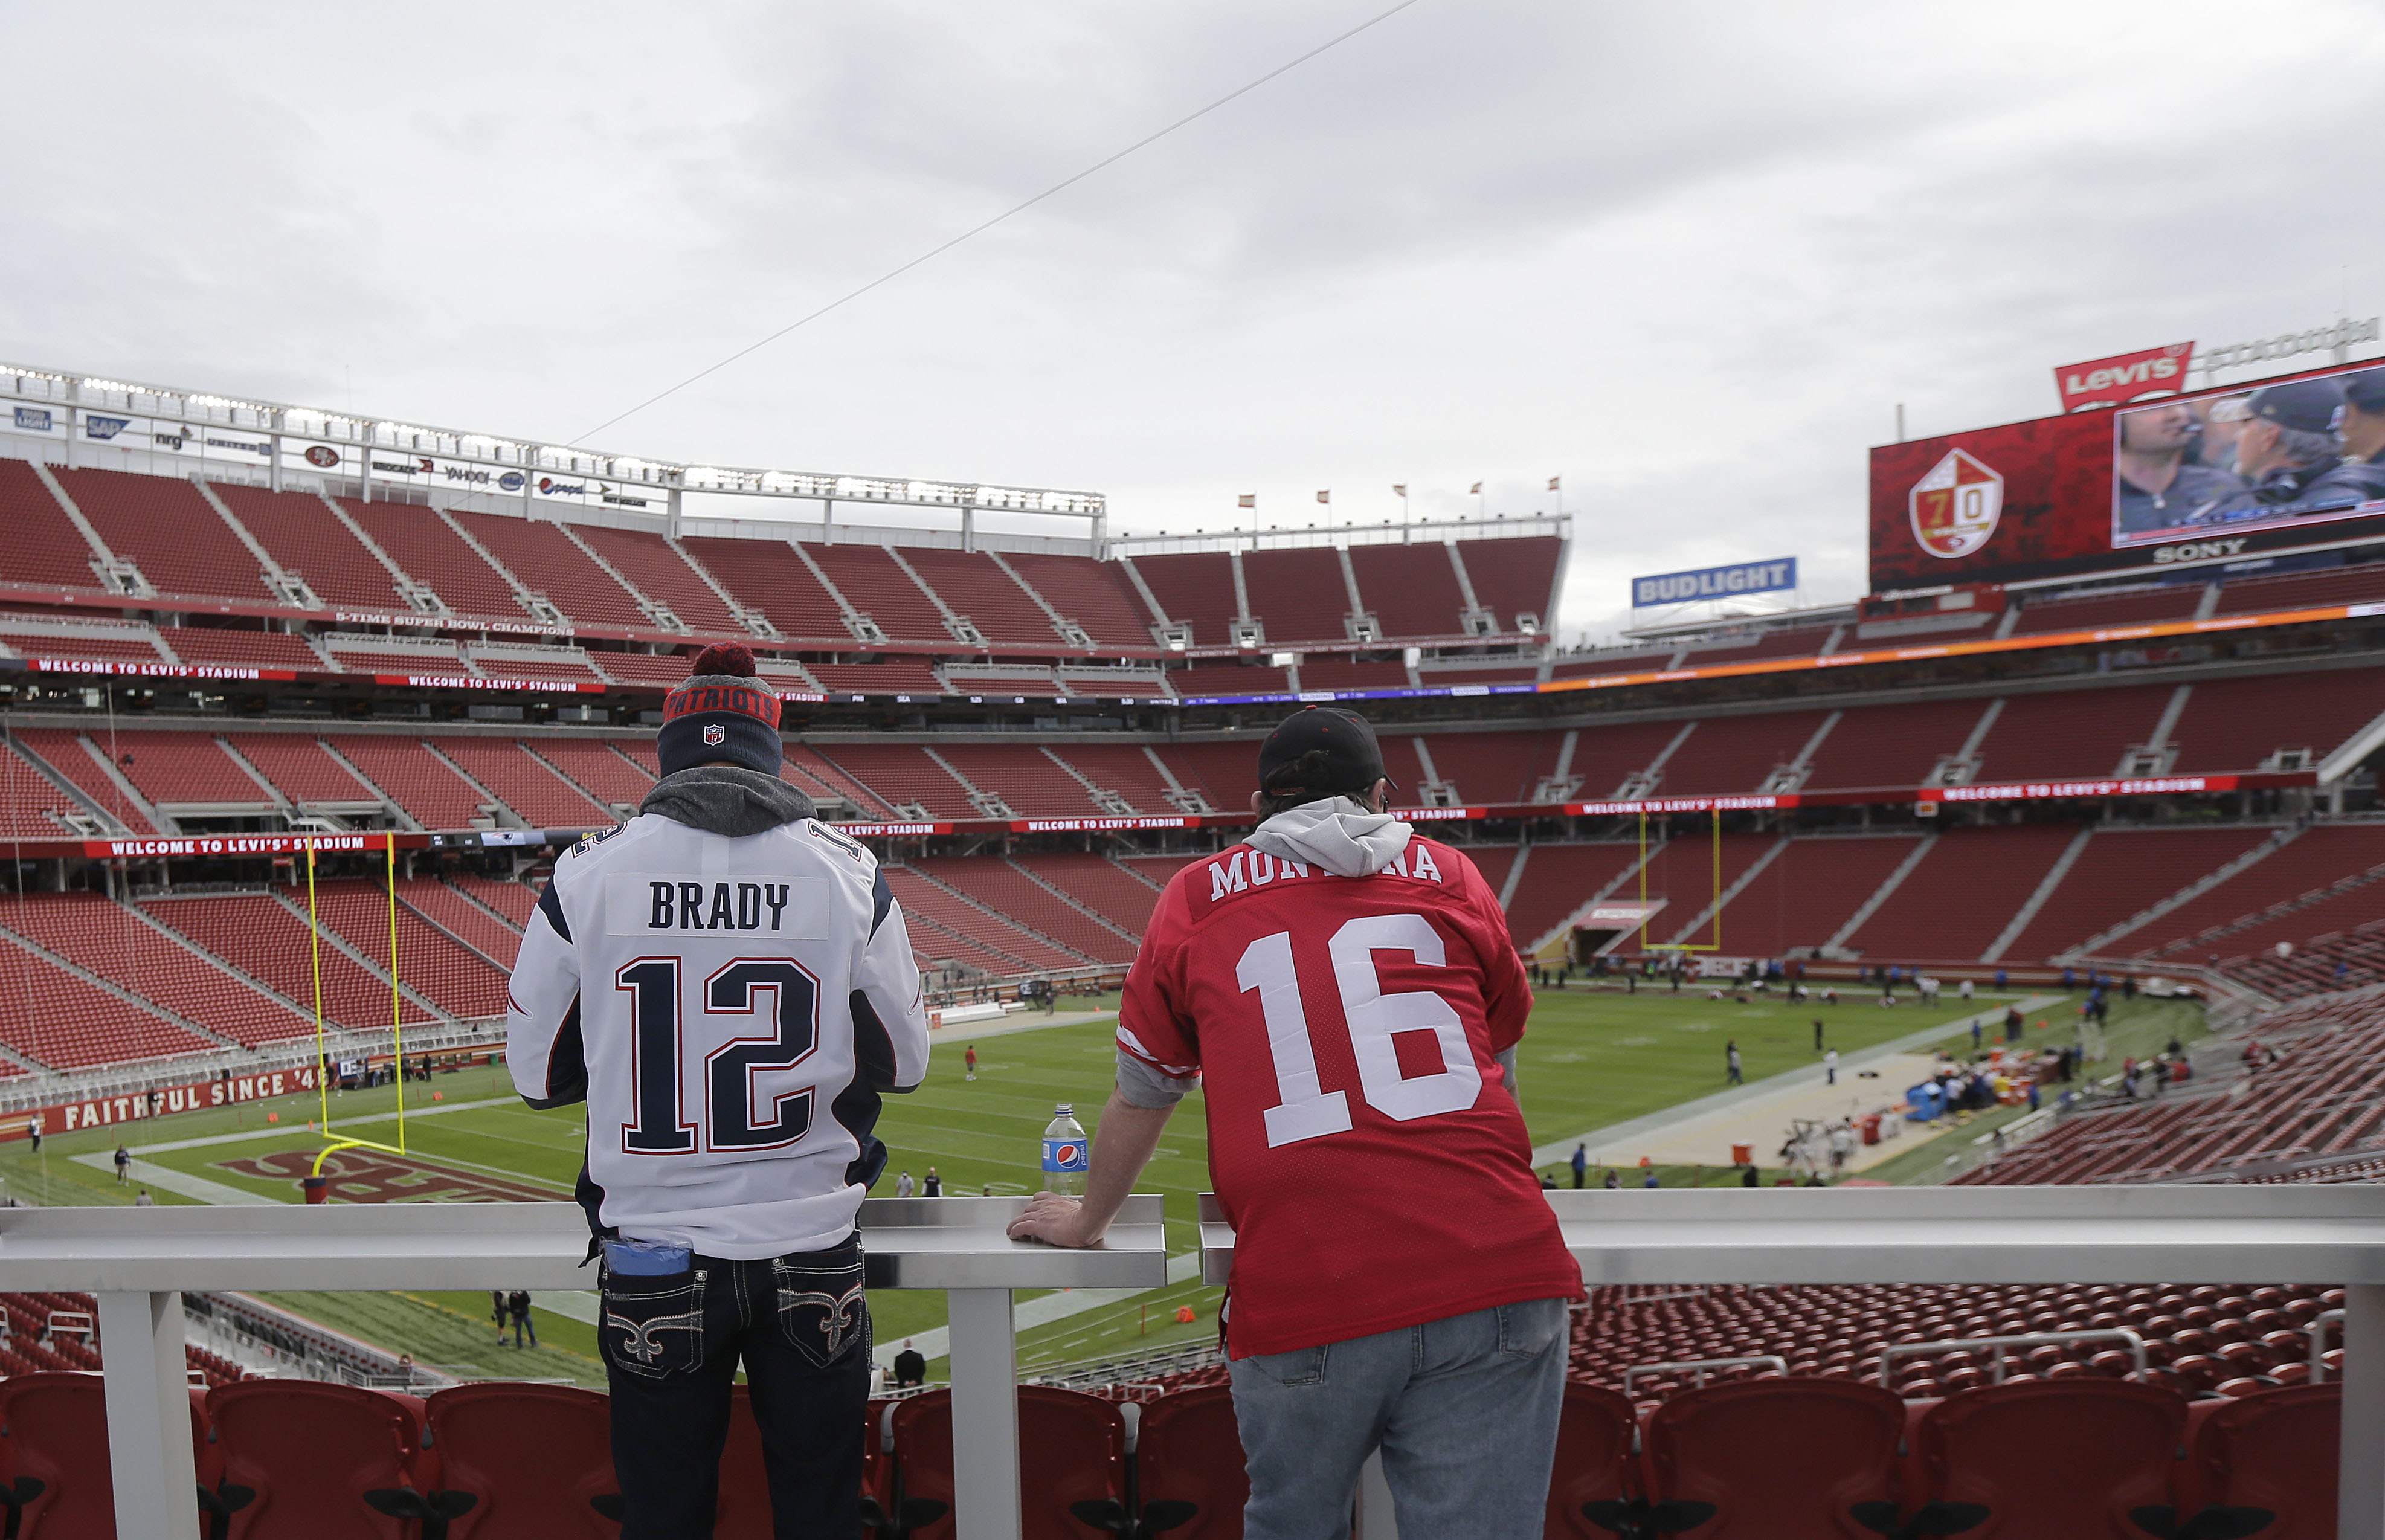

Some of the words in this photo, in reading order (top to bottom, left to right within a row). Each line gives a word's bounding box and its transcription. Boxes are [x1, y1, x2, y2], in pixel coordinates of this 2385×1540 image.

[156, 433, 182, 450] nrg
[2154, 537, 2248, 564] SONY
[394, 616, 444, 627] SUPER
[448, 619, 489, 630] BOWL
[492, 622, 575, 636] CHAMPIONS
[39, 660, 114, 674] WELCOME
[118, 663, 136, 674] TO
[197, 666, 259, 679] STADIUM
[408, 676, 465, 687] WELCOME
[469, 678, 483, 688] TO
[529, 681, 577, 691] STADIUM
[667, 689, 773, 721] PATRIOTS
[785, 693, 824, 701] STADIUM
[1943, 785, 2023, 801] WELCOME
[2026, 784, 2050, 797] TO
[2120, 778, 2205, 793] STADIUM
[1411, 809, 1466, 820] STADIUM
[1583, 802, 1643, 814] WELCOME
[1645, 801, 1662, 811] TO
[1714, 796, 1776, 808] STADIUM
[887, 825, 934, 834] STADIUM
[1028, 821, 1080, 830] WELCOME
[1083, 820, 1096, 829] TO
[1139, 818, 1184, 828] STADIUM
[111, 840, 194, 855] WELCOME
[200, 839, 222, 854] TO
[294, 837, 364, 851] STADIUM
[648, 881, 790, 930] BRADY
[1235, 913, 1482, 1149] 16
[615, 956, 820, 1155] 12
[65, 1087, 201, 1131] FAITHFUL
[211, 1073, 284, 1105] SINCE
